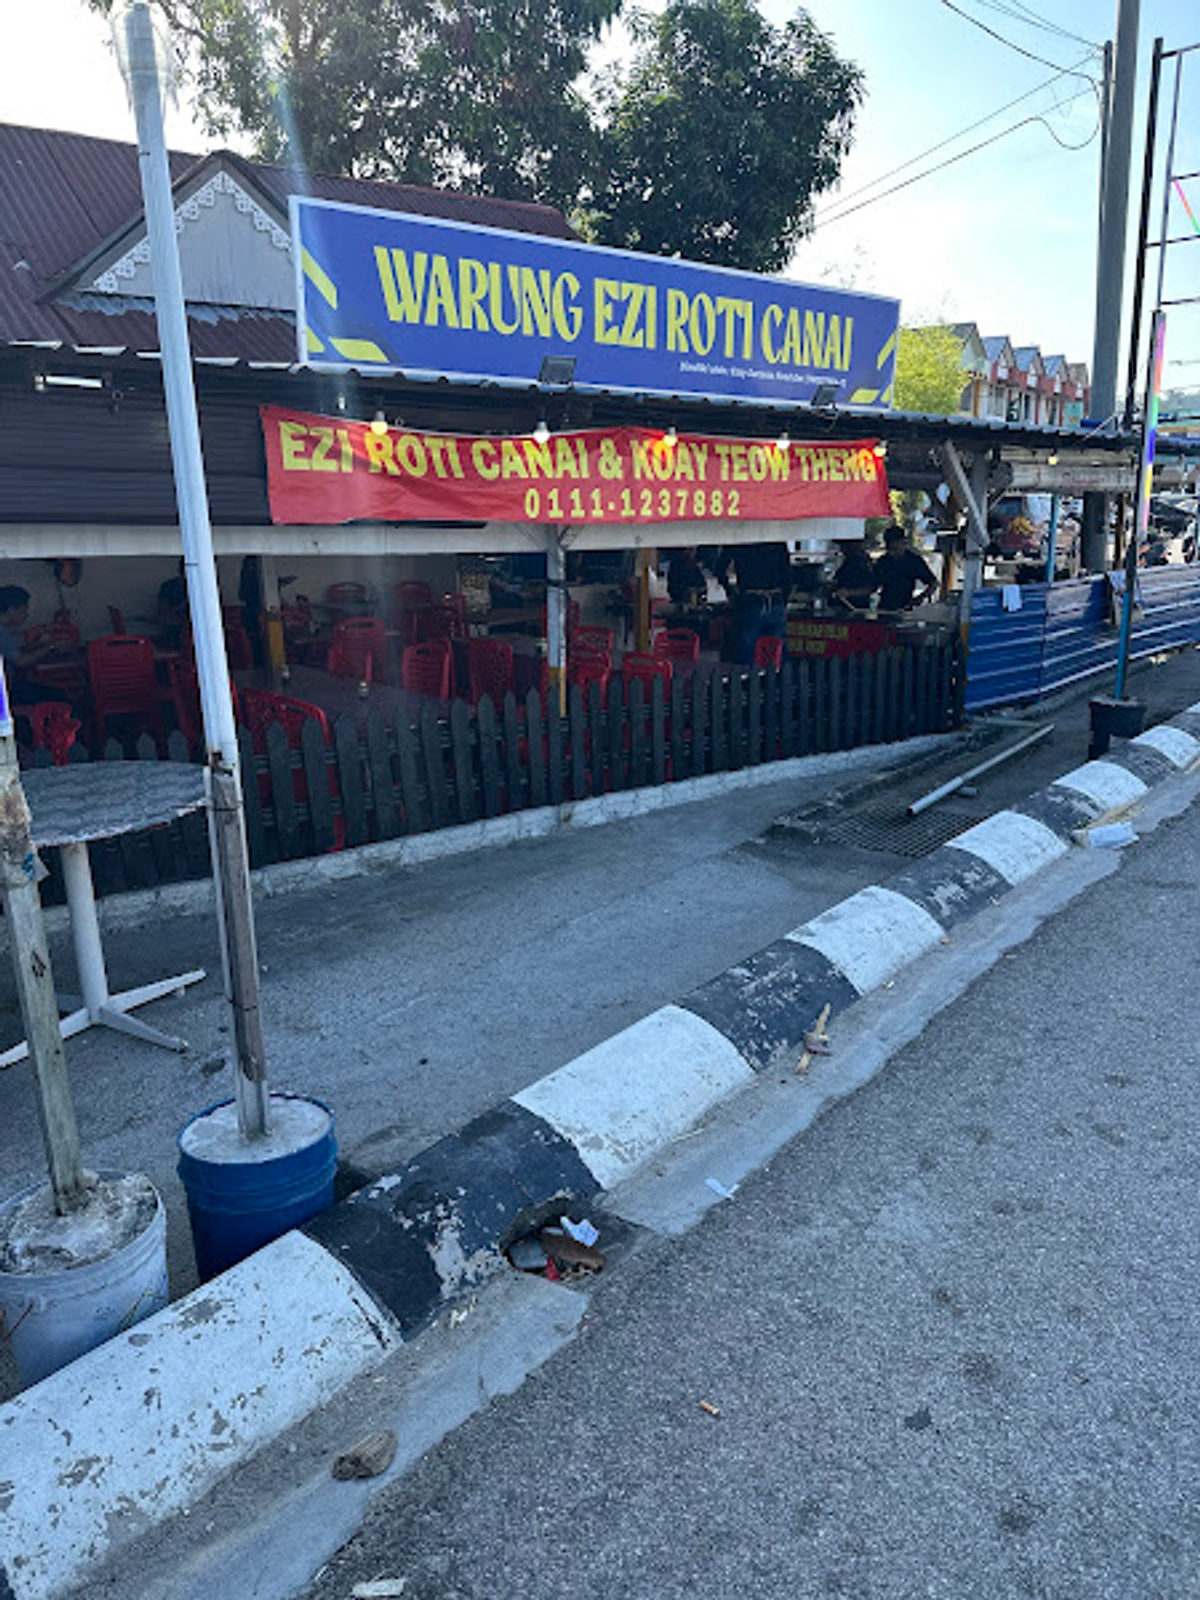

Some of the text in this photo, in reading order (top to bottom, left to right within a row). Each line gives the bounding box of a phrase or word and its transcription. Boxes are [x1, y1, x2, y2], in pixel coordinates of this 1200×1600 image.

[373, 245, 853, 372] WARUNG EZI ROTI CANAI
[279, 421, 354, 473] EZI
[364, 431, 465, 478] ROTI
[471, 438, 590, 480] CANAI
[598, 438, 623, 481] &
[715, 444, 790, 482] TEOW
[795, 447, 877, 482] THENG
